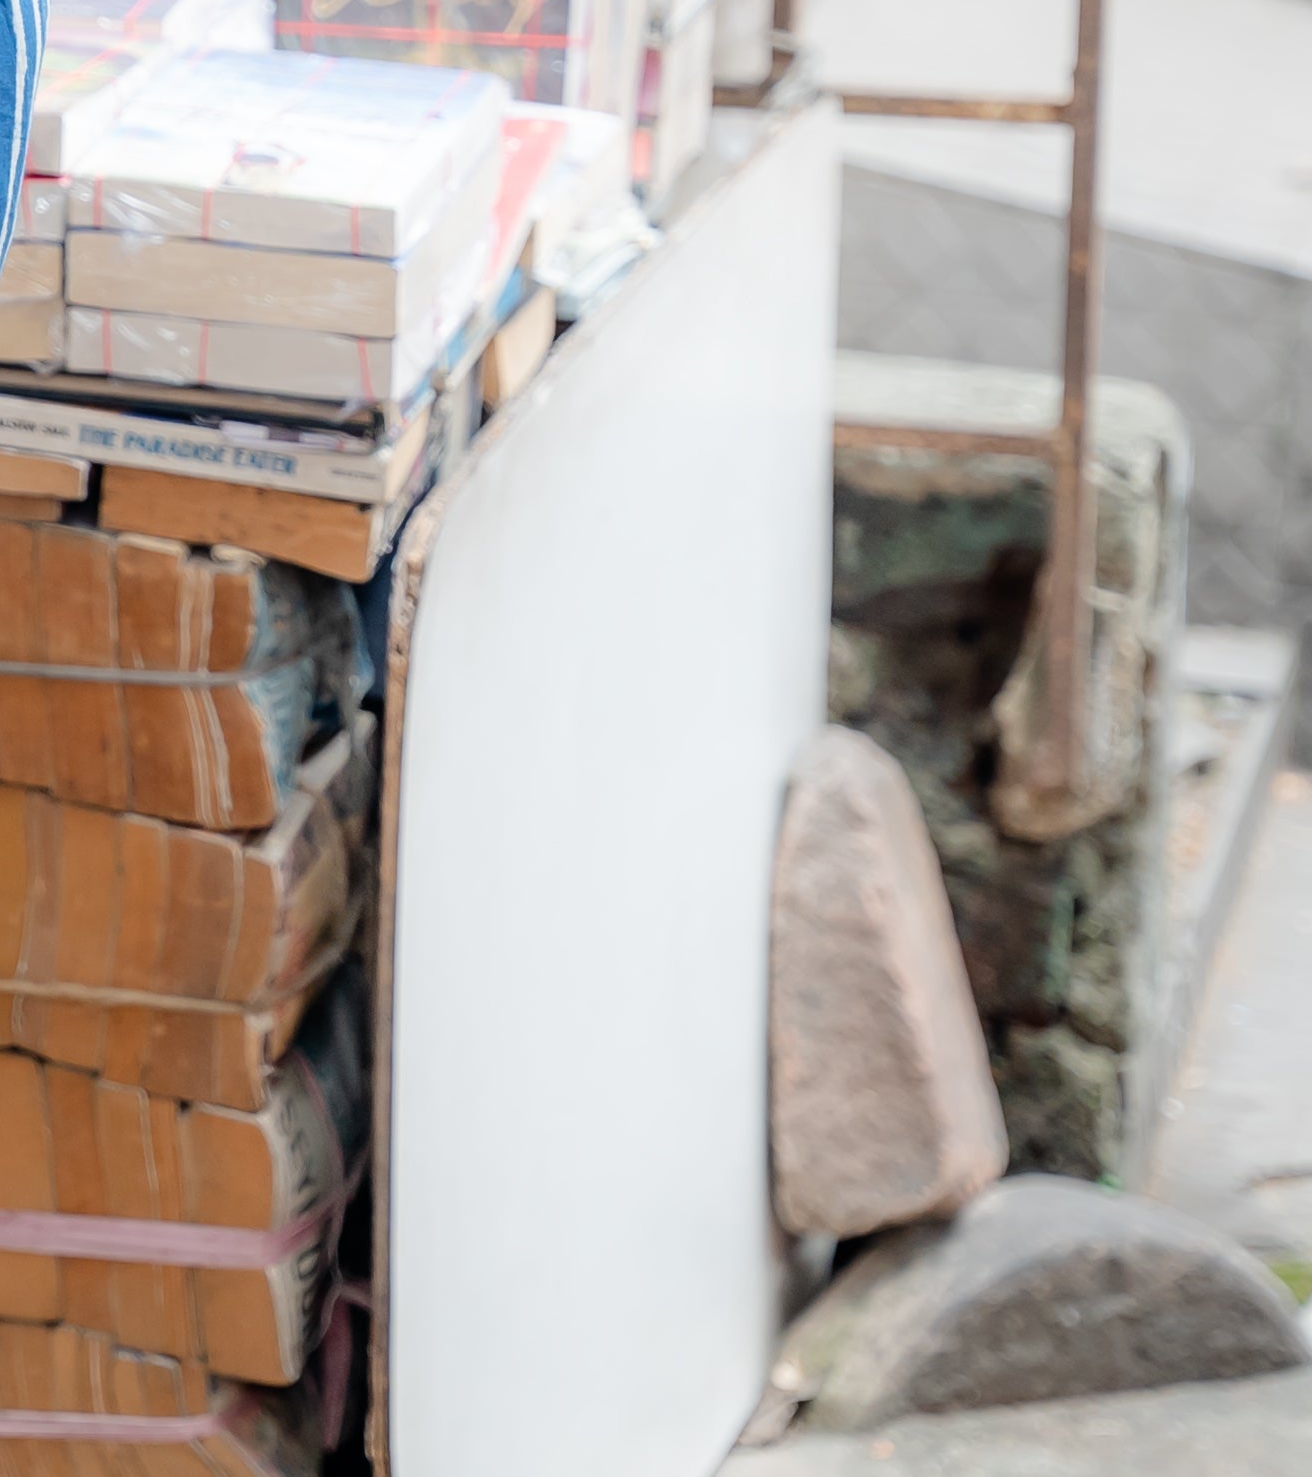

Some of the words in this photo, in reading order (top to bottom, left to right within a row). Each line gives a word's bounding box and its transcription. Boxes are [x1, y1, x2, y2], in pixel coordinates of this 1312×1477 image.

[77, 423, 119, 450] THE
[121, 430, 229, 466] PARADISE
[232, 442, 297, 478] EATER
